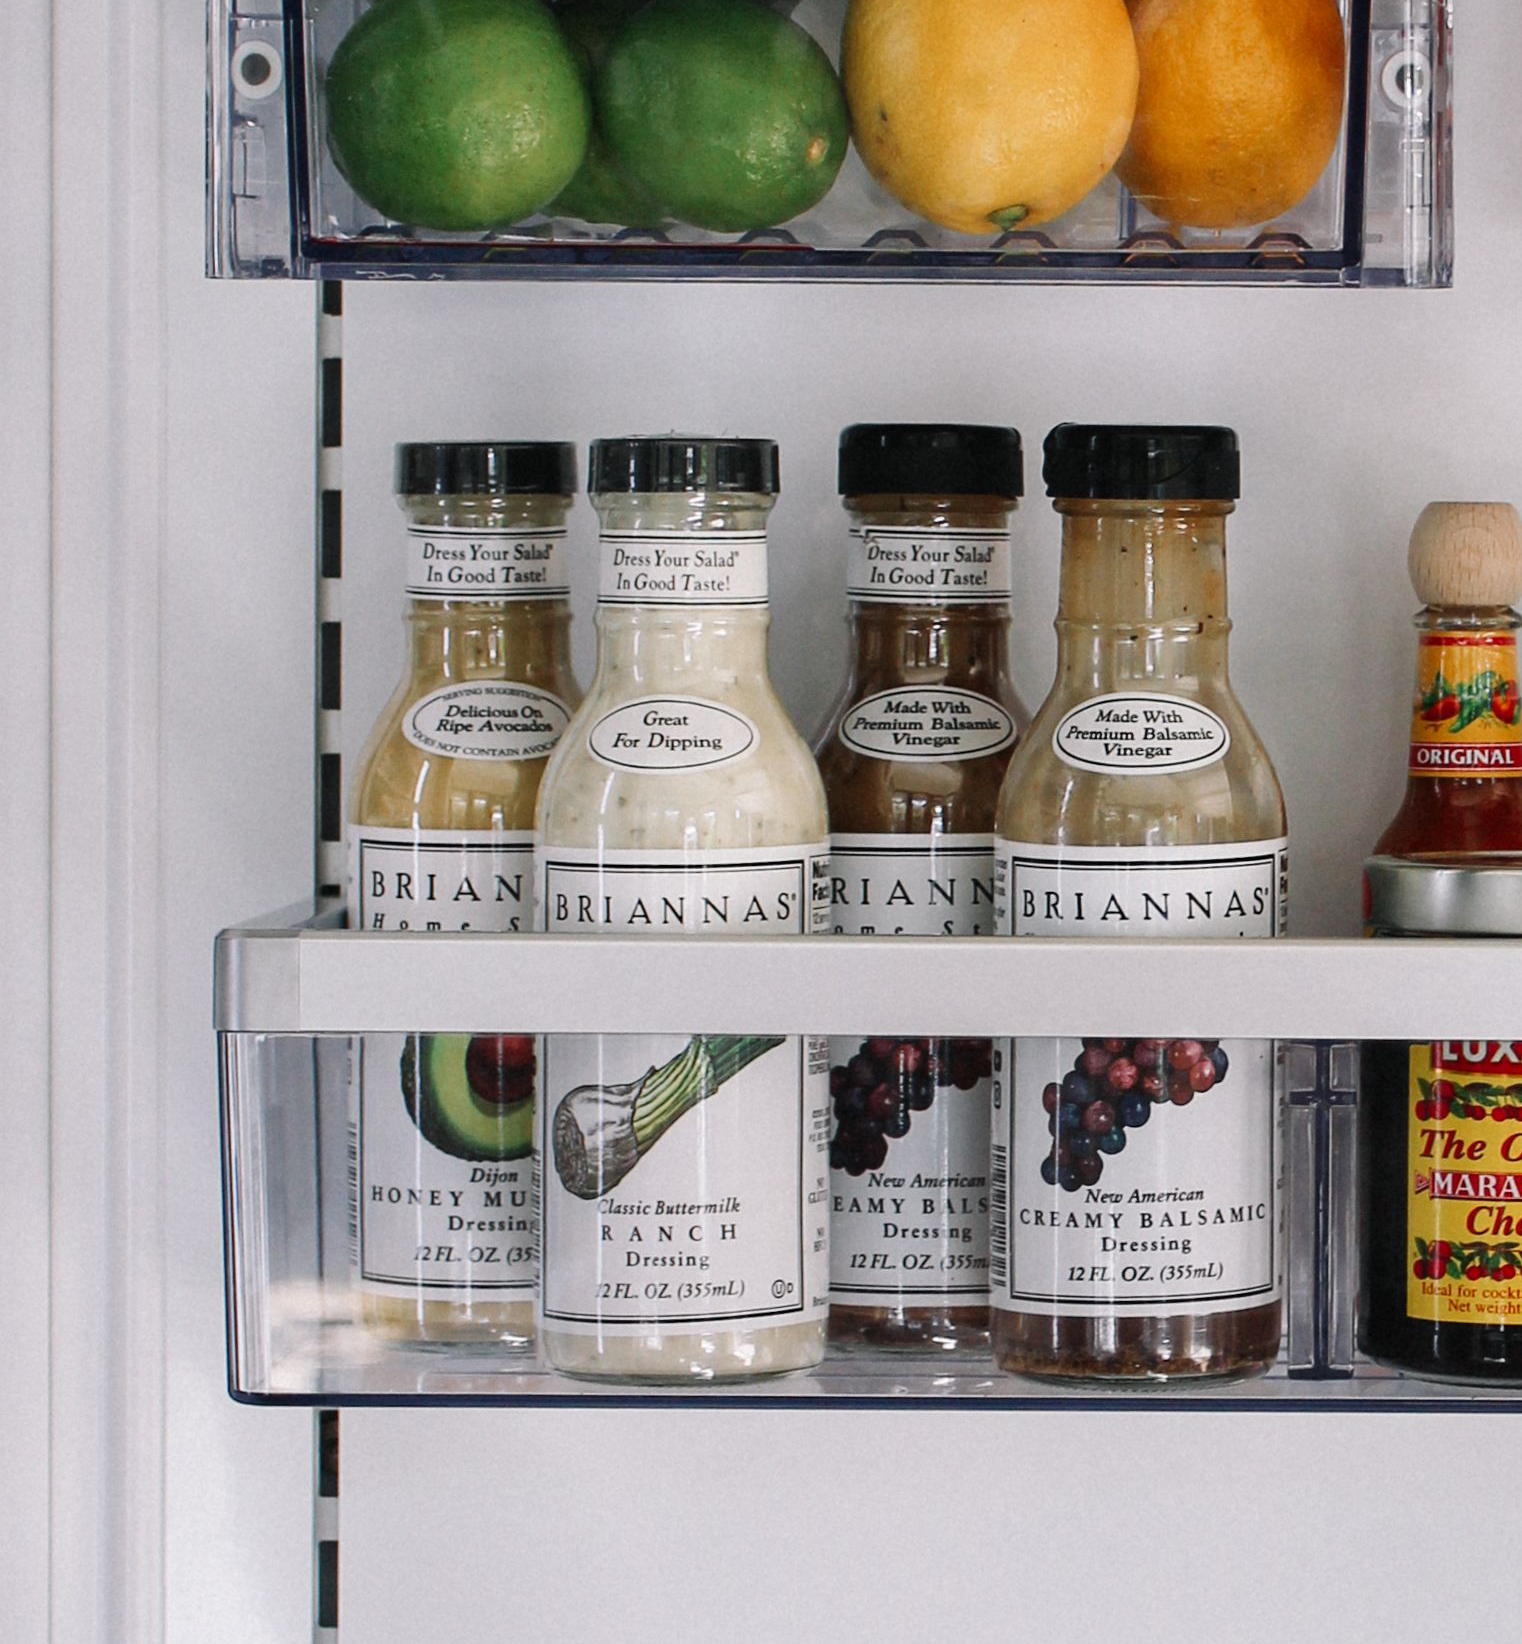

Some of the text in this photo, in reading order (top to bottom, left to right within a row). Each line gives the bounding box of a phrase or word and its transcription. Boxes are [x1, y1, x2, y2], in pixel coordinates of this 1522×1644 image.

[423, 543, 509, 562] Dress Your
[613, 548, 689, 568] Dress Your
[911, 546, 949, 563] Your
[447, 565, 496, 584] Good
[633, 574, 675, 591] Good
[890, 568, 934, 585] Good
[445, 705, 517, 721] Delicious
[883, 701, 971, 715] Made With
[1095, 709, 1182, 724] Made With
[436, 720, 552, 736] Ripe Avocados
[643, 711, 689, 728] Great
[852, 717, 1001, 732] Premium Balsamic
[612, 732, 722, 751] For Dipping
[893, 733, 960, 748] Vinegar
[1065, 726, 1214, 742] Premium Balsamic
[1103, 743, 1172, 759] Vinegar
[1417, 748, 1514, 766] ORIGINAL
[1420, 1129, 1486, 1161] The
[470, 1167, 518, 1186] Dijon
[868, 1173, 986, 1189] New American
[372, 1185, 462, 1206] HONEY
[1085, 1188, 1205, 1204] New American
[654, 1199, 741, 1215] Buttermilk
[1019, 1203, 1265, 1229] CREAMY BALSAMIC
[601, 1223, 738, 1242] RANCH
[1101, 1237, 1192, 1254] Dressing
[626, 1252, 710, 1270] Dressing
[1458, 1283, 1476, 1298] for
[1448, 1299, 1469, 1312] Net
[1475, 1301, 1521, 1315] weight
